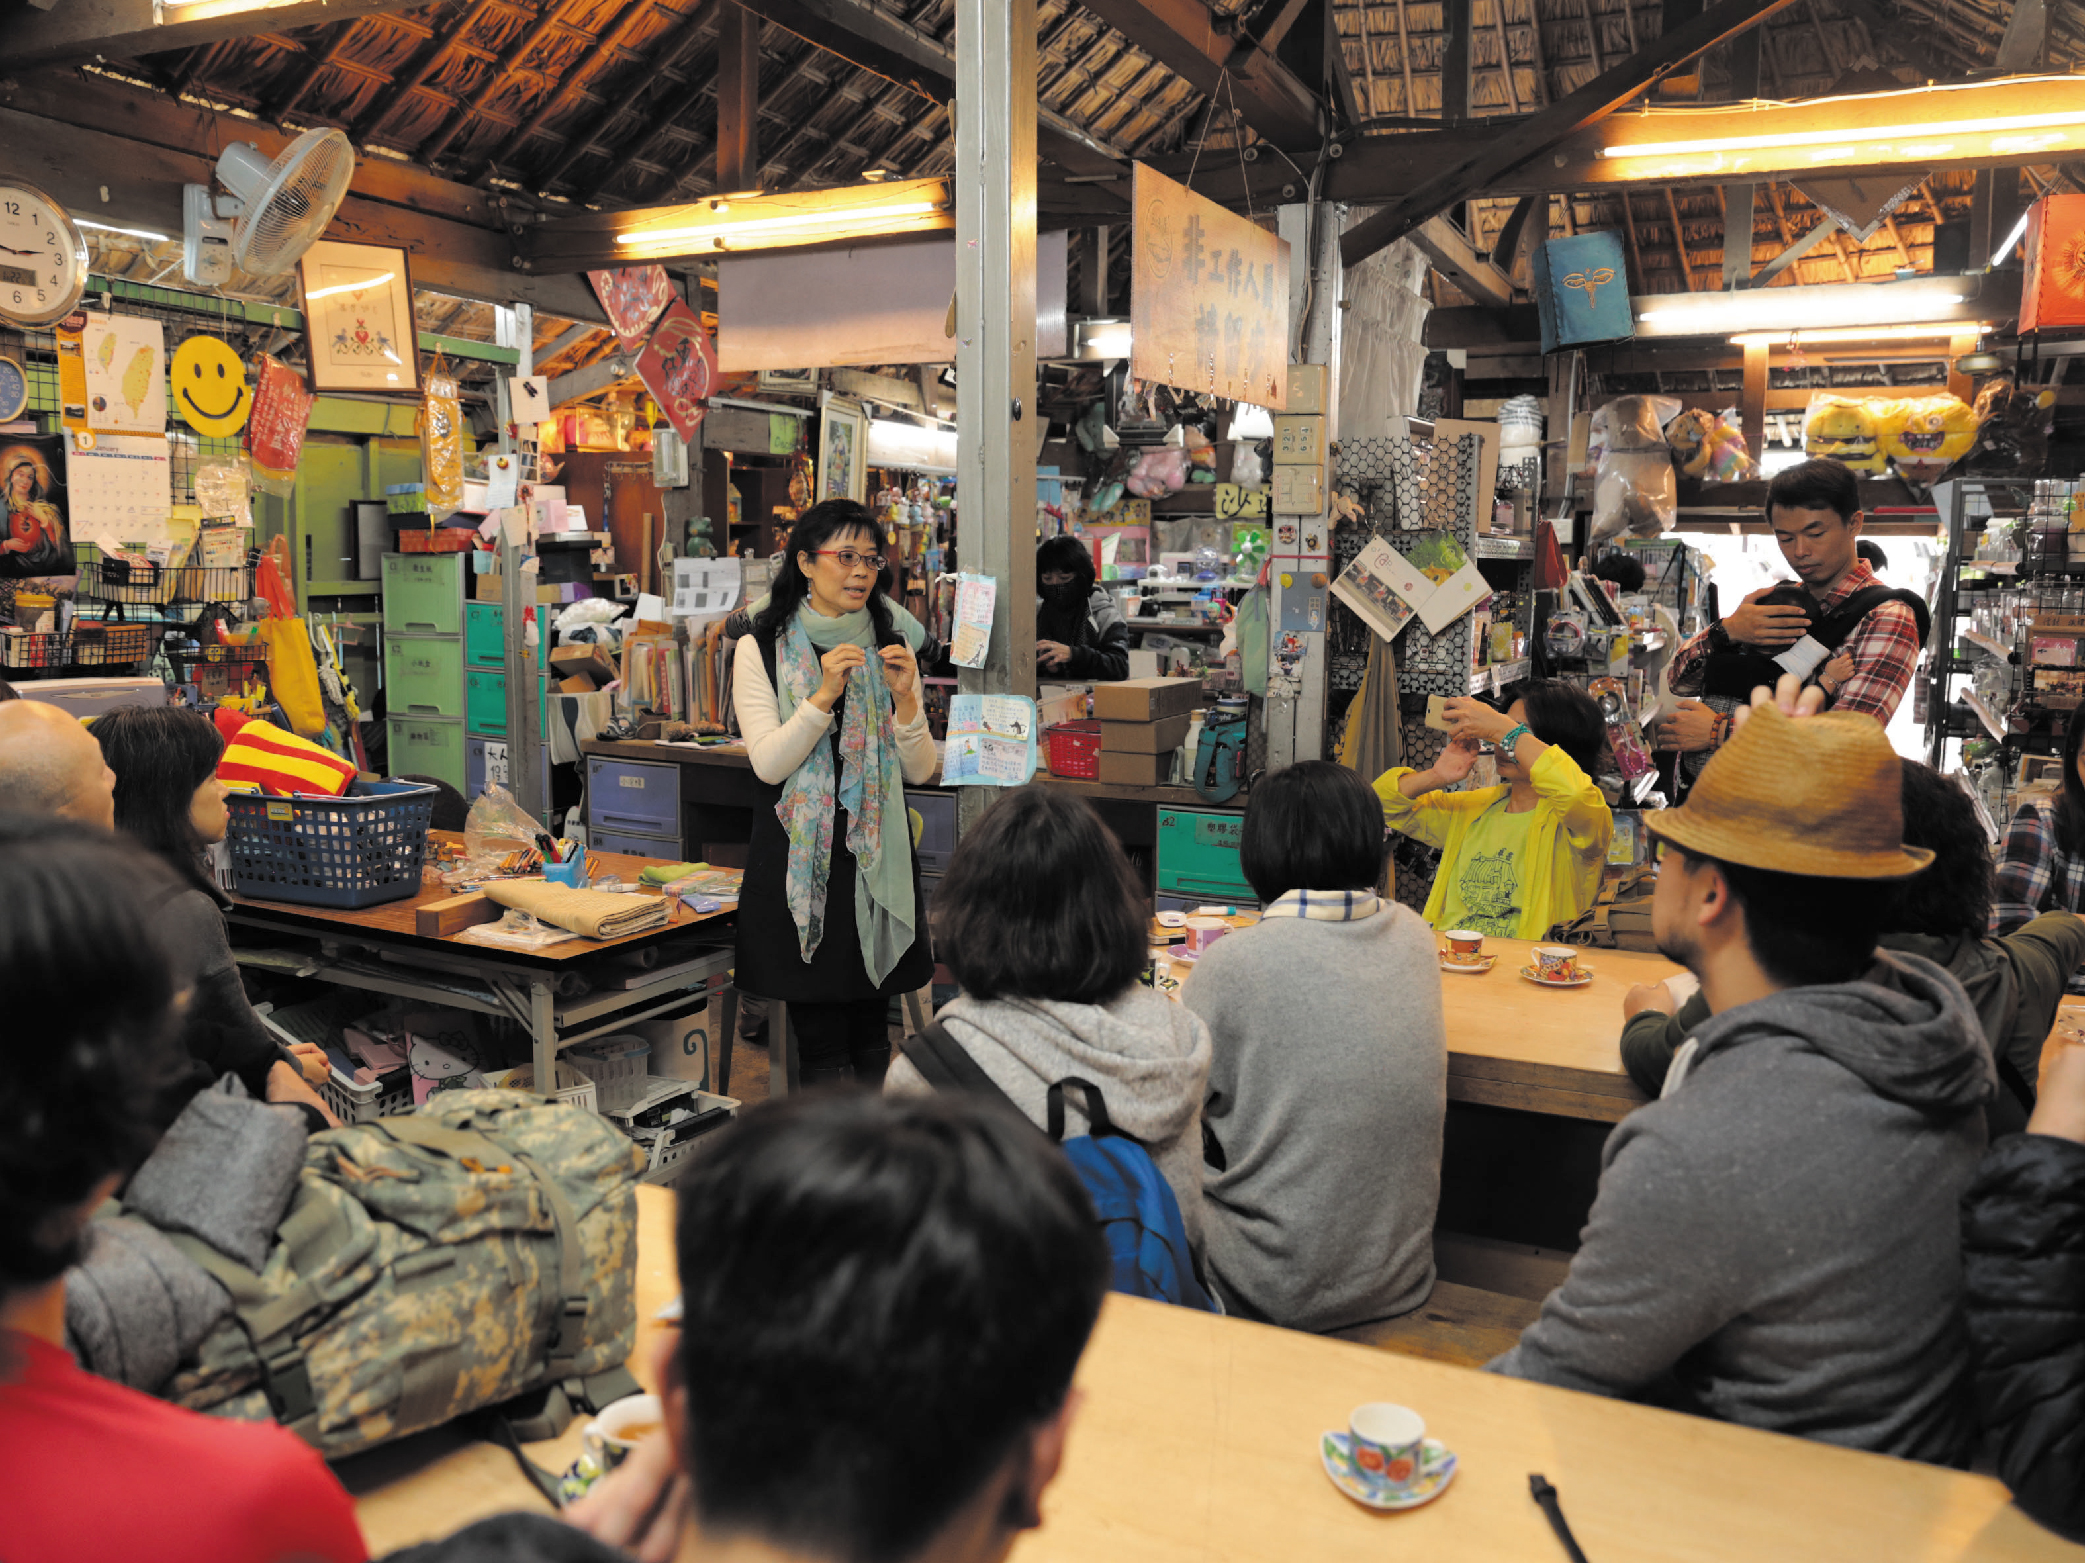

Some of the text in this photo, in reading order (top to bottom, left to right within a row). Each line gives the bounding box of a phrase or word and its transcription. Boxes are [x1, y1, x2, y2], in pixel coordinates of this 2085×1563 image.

[4, 201, 20, 216] 12
[32, 213, 39, 226] 1
[46, 231, 56, 245] 2
[54, 252, 63, 266] 3
[50, 274, 59, 287] 4
[13, 290, 22, 303] 6
[37, 289, 46, 302] 5
[1207, 821, 1245, 836] 塑膠袋
